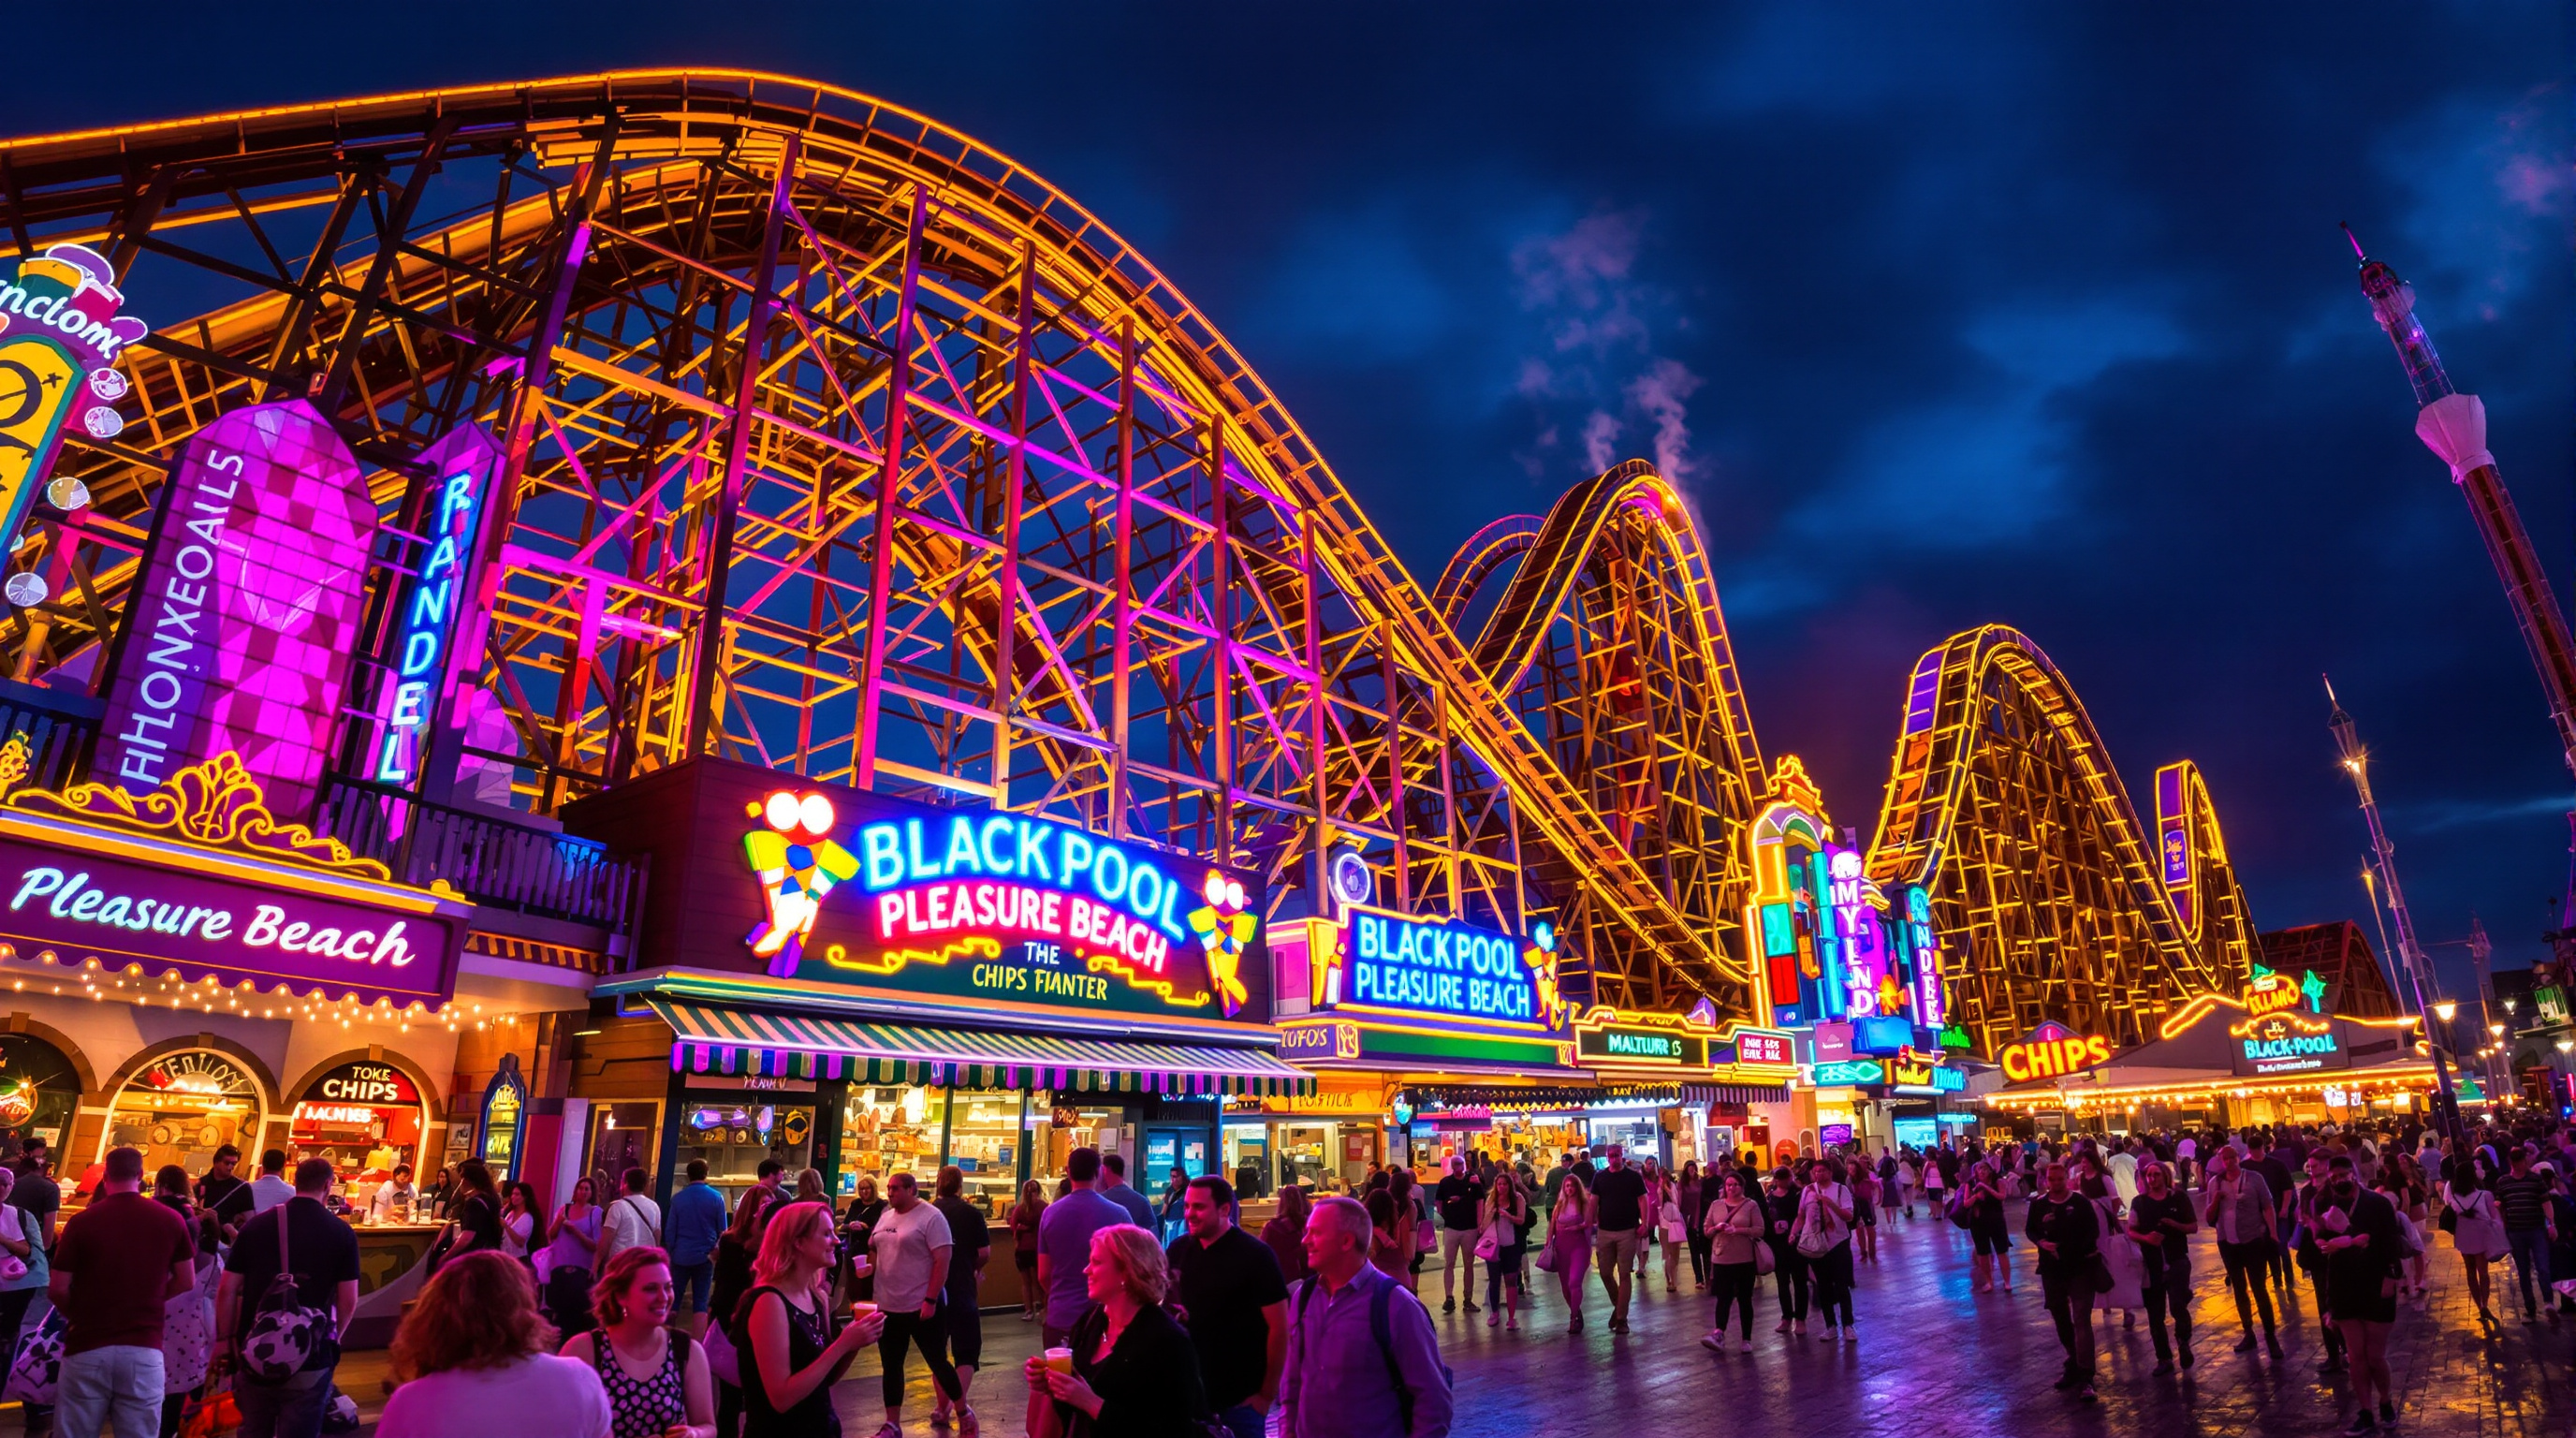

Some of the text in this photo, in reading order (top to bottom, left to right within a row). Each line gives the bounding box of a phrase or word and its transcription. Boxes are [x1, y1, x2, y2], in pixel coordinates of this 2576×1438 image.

[378, 473, 475, 782] RANDEL
[9, 867, 417, 967] Pleasure Beach
[880, 885, 1168, 974] PLEASURE BEACH
[972, 963, 1027, 991] CHIPS
[1024, 941, 1061, 965] THE
[1355, 961, 1531, 1019] PLEASURE BEACH
[2002, 1034, 2111, 1080] CHIPS
[323, 1078, 399, 1101] CHIPS
